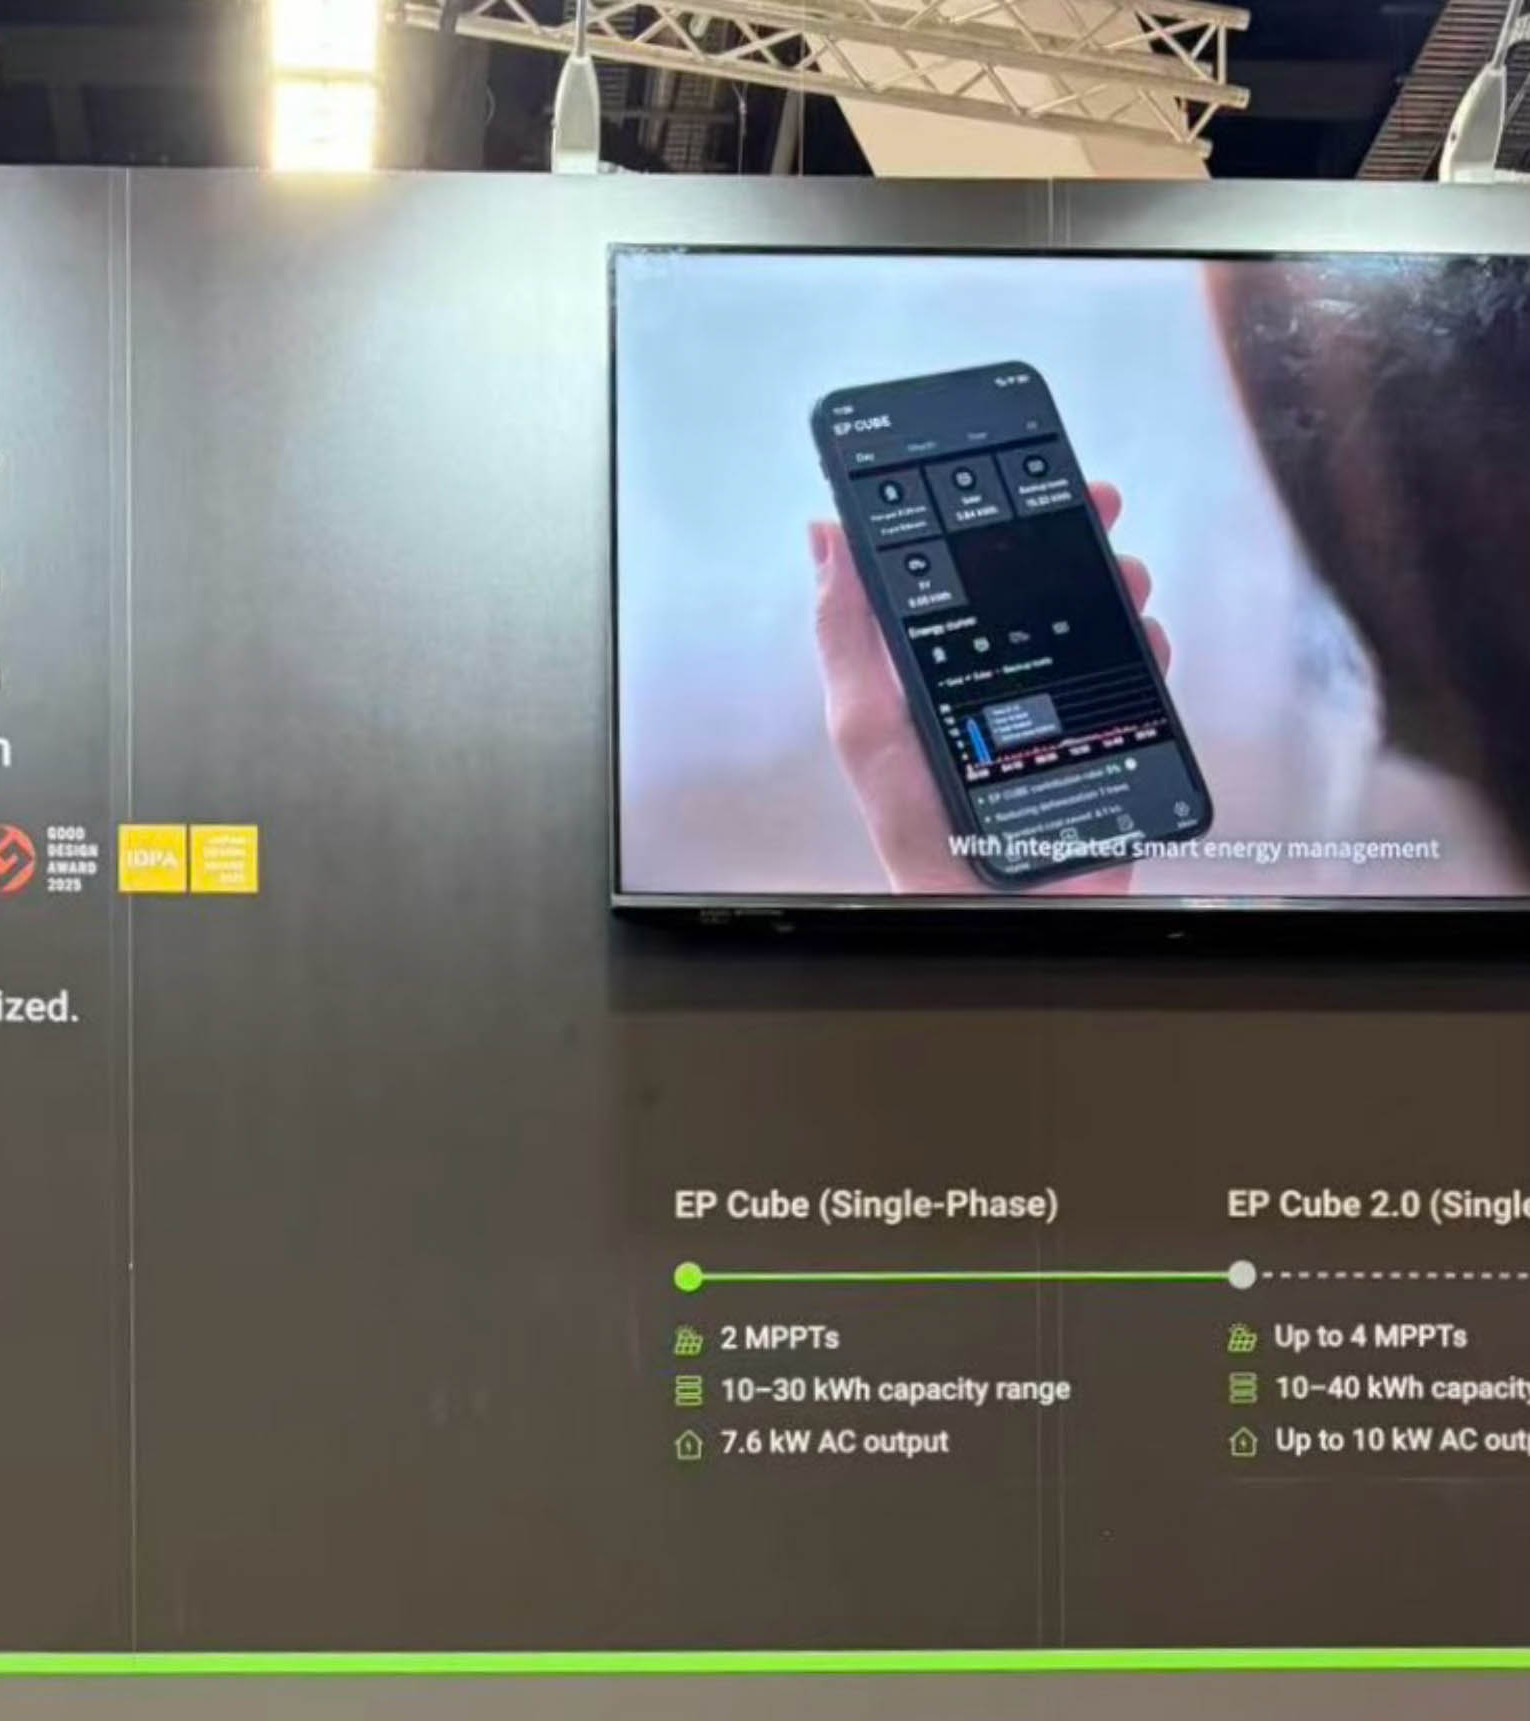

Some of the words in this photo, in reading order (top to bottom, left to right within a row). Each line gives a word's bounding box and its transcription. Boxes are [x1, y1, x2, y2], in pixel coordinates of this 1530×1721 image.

[948, 836, 1002, 857] With
[1006, 834, 1127, 861] integrated
[1132, 841, 1200, 858] smart
[1203, 841, 1282, 866] energy
[1287, 838, 1440, 866] management
[675, 1189, 718, 1219] EP
[726, 1188, 810, 1219] Cube
[819, 1187, 1058, 1226] (Single-Phase)
[1228, 1189, 1270, 1218] EP
[1279, 1188, 1362, 1218] Cube
[1370, 1189, 1421, 1218] 2.0
[720, 1325, 738, 1350] 2
[745, 1325, 840, 1350] MPPTs
[813, 1376, 871, 1402] kWh
[877, 1376, 990, 1407] capacity
[996, 1381, 1071, 1406] range
